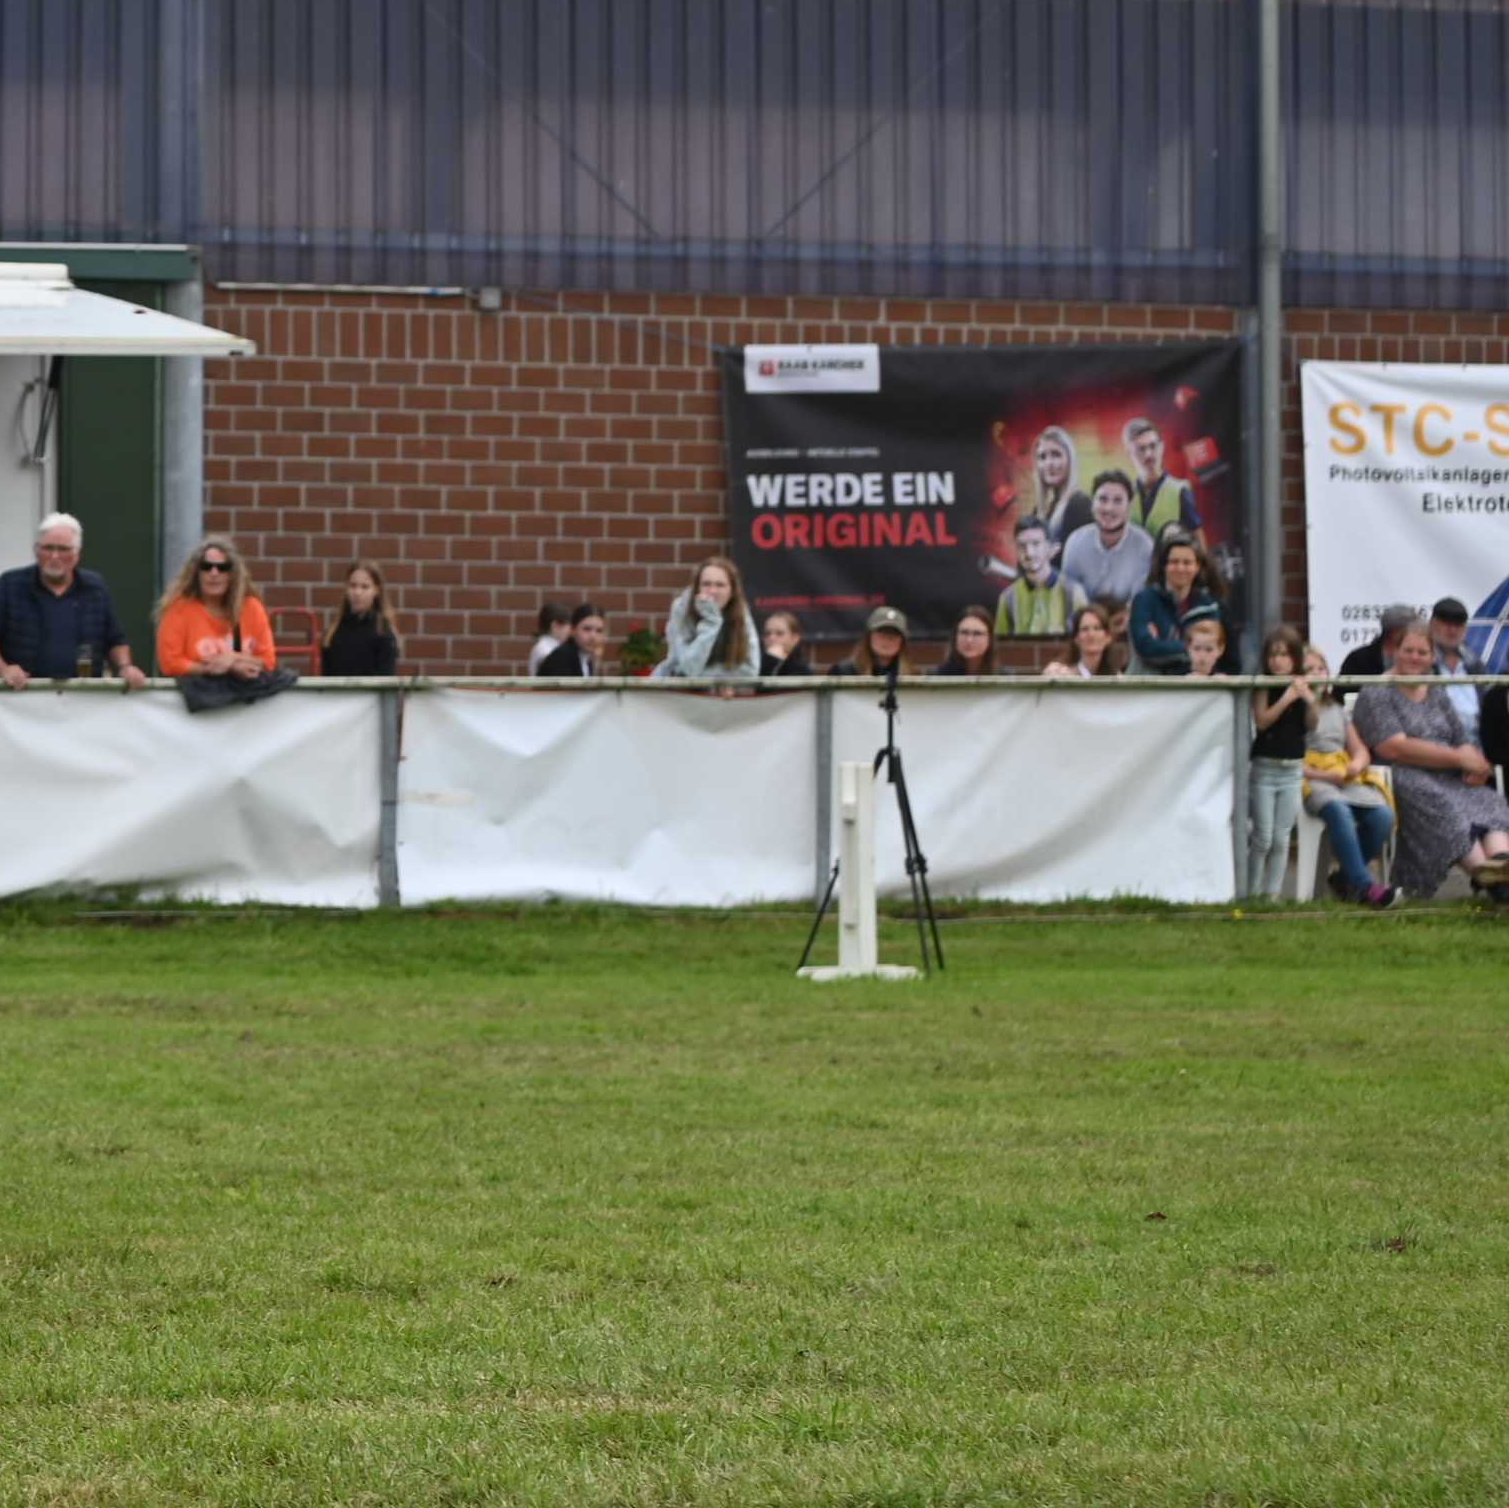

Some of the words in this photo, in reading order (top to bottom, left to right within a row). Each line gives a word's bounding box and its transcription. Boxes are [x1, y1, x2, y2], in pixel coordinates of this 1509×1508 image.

[746, 472, 885, 508] WERDE
[892, 470, 956, 505] EIN
[750, 511, 958, 549] ORIGINAL
